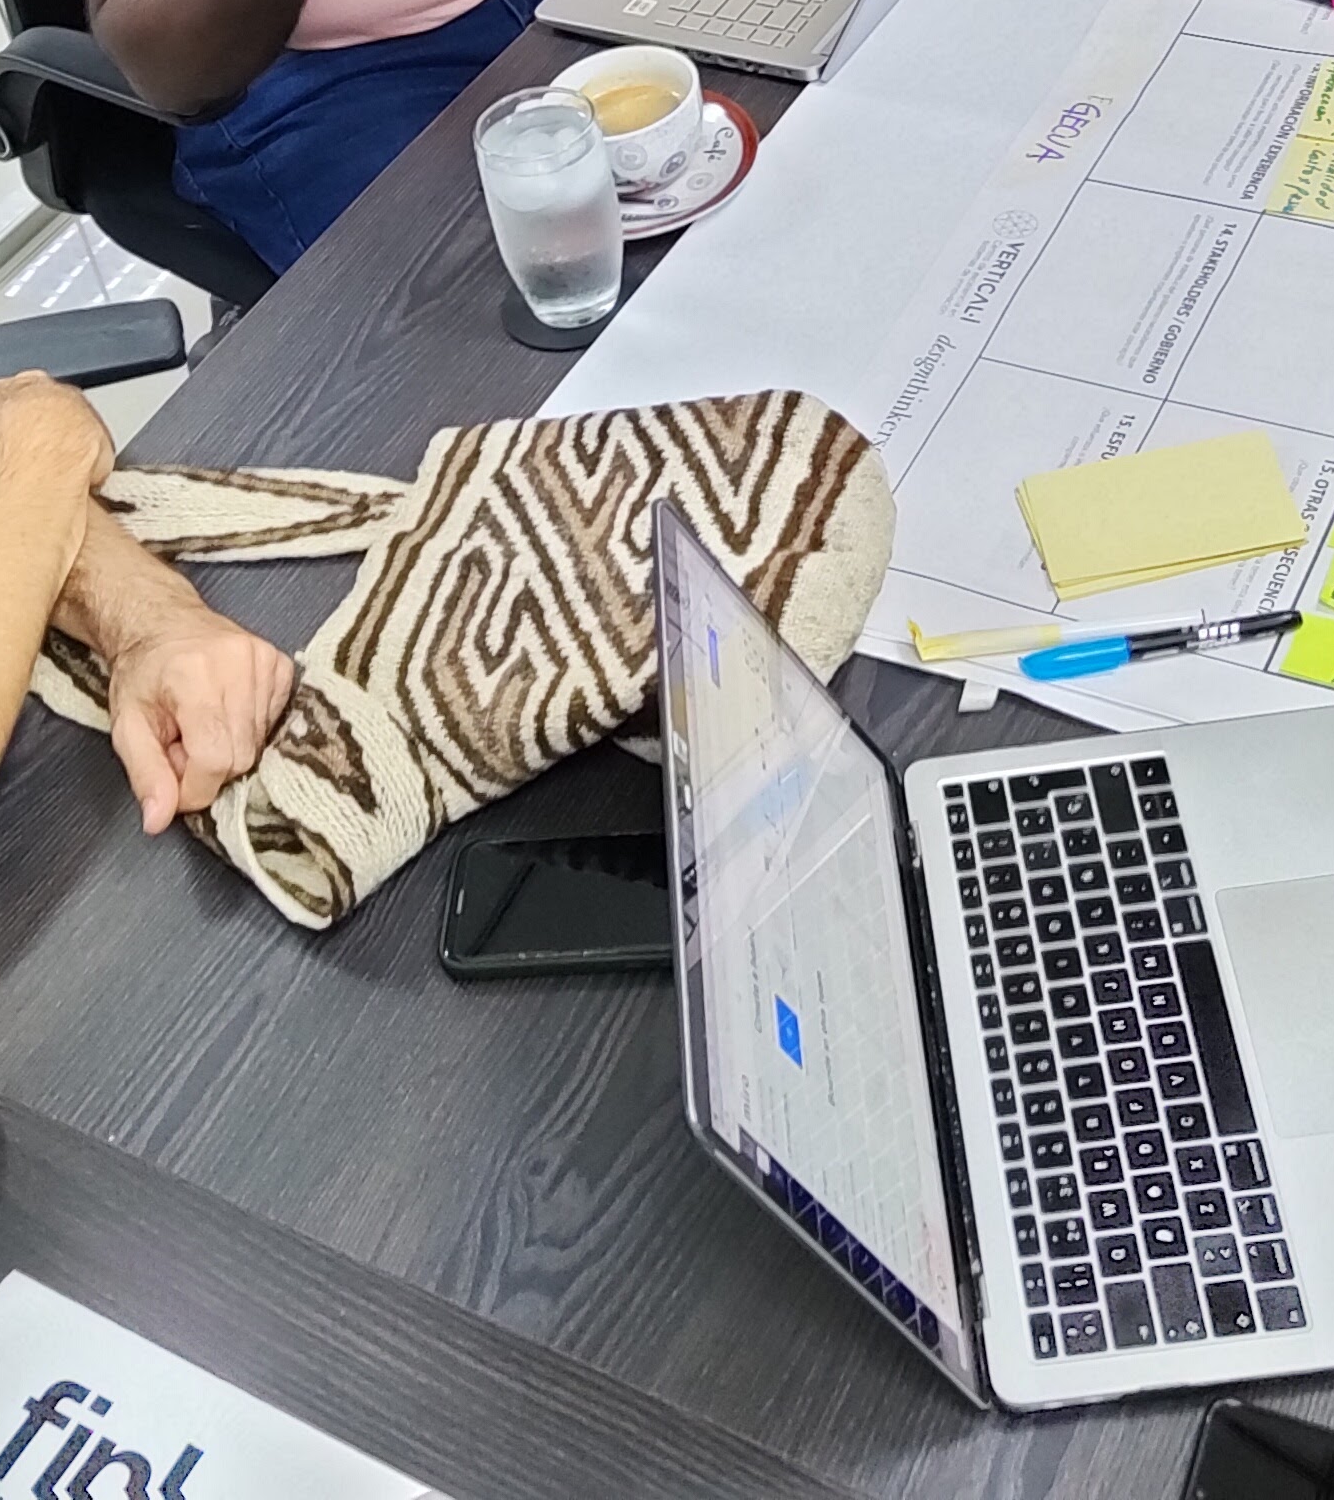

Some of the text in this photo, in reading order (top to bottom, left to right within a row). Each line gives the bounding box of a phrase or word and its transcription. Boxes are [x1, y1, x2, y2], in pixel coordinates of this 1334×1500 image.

[1239, 145, 1282, 200] EXPERIENCIA
[1216, 222, 1237, 237] 14.
[1175, 240, 1228, 316] STAKEHOLDERS
[1140, 325, 1182, 383] GOBIERNO
[1098, 413, 1136, 460] 15. ESFU
[1298, 480, 1330, 519] OTRAS
